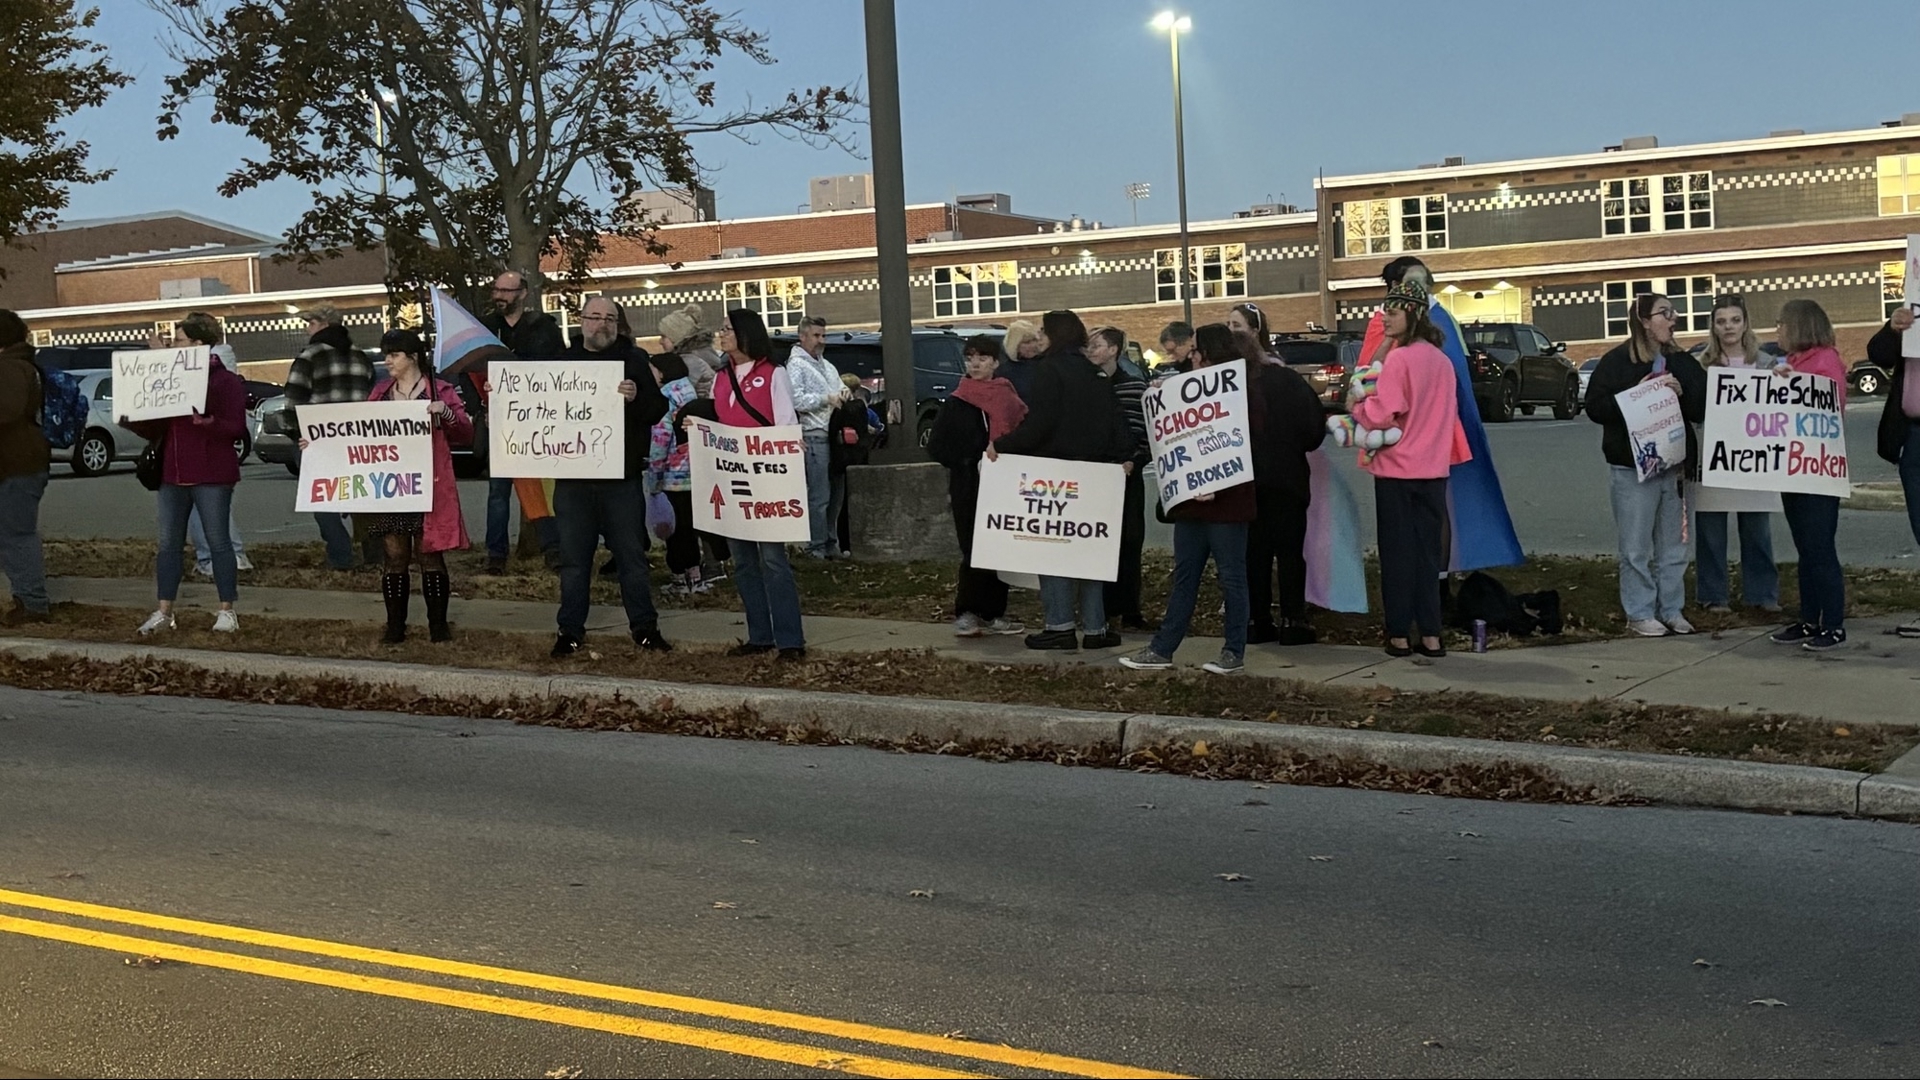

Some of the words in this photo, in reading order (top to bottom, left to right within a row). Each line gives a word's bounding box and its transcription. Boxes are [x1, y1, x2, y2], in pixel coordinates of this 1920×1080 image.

[119, 356, 145, 377] We
[149, 362, 167, 375] are
[171, 349, 203, 371] ALL
[497, 367, 520, 394] Are
[525, 372, 547, 393] You
[549, 370, 597, 395] Working
[1181, 368, 1239, 404] OUR
[1629, 380, 1667, 401] SUPPOR
[1715, 373, 1747, 405] Fix
[1750, 375, 1789, 405] The
[1789, 375, 1840, 413] School!
[134, 391, 187, 409] Children
[507, 400, 531, 421] For
[536, 401, 557, 420] the
[1647, 394, 1678, 414] TRANS
[307, 418, 430, 441] DISCRIMINATION
[543, 425, 555, 436] or
[1154, 401, 1230, 442] SCHOOL
[1633, 412, 1682, 439] STUDENTS
[1745, 412, 1789, 438] OUR
[1795, 412, 1840, 439] KIDS
[347, 444, 399, 465] HURTS
[502, 430, 529, 455] Your
[745, 435, 800, 455] HATE
[716, 457, 748, 474] LEGAL
[752, 462, 787, 475] FEES
[1157, 445, 1192, 479] OUR
[1709, 440, 1785, 473] Aren't
[1787, 440, 1847, 478] Broken
[1019, 472, 1078, 499] LOVE
[1185, 456, 1244, 491] BROKEN
[311, 471, 422, 503] EVERYONE
[739, 499, 804, 520] TAXES
[1024, 497, 1067, 516] THY
[987, 513, 1109, 538] NEIGHBOR
